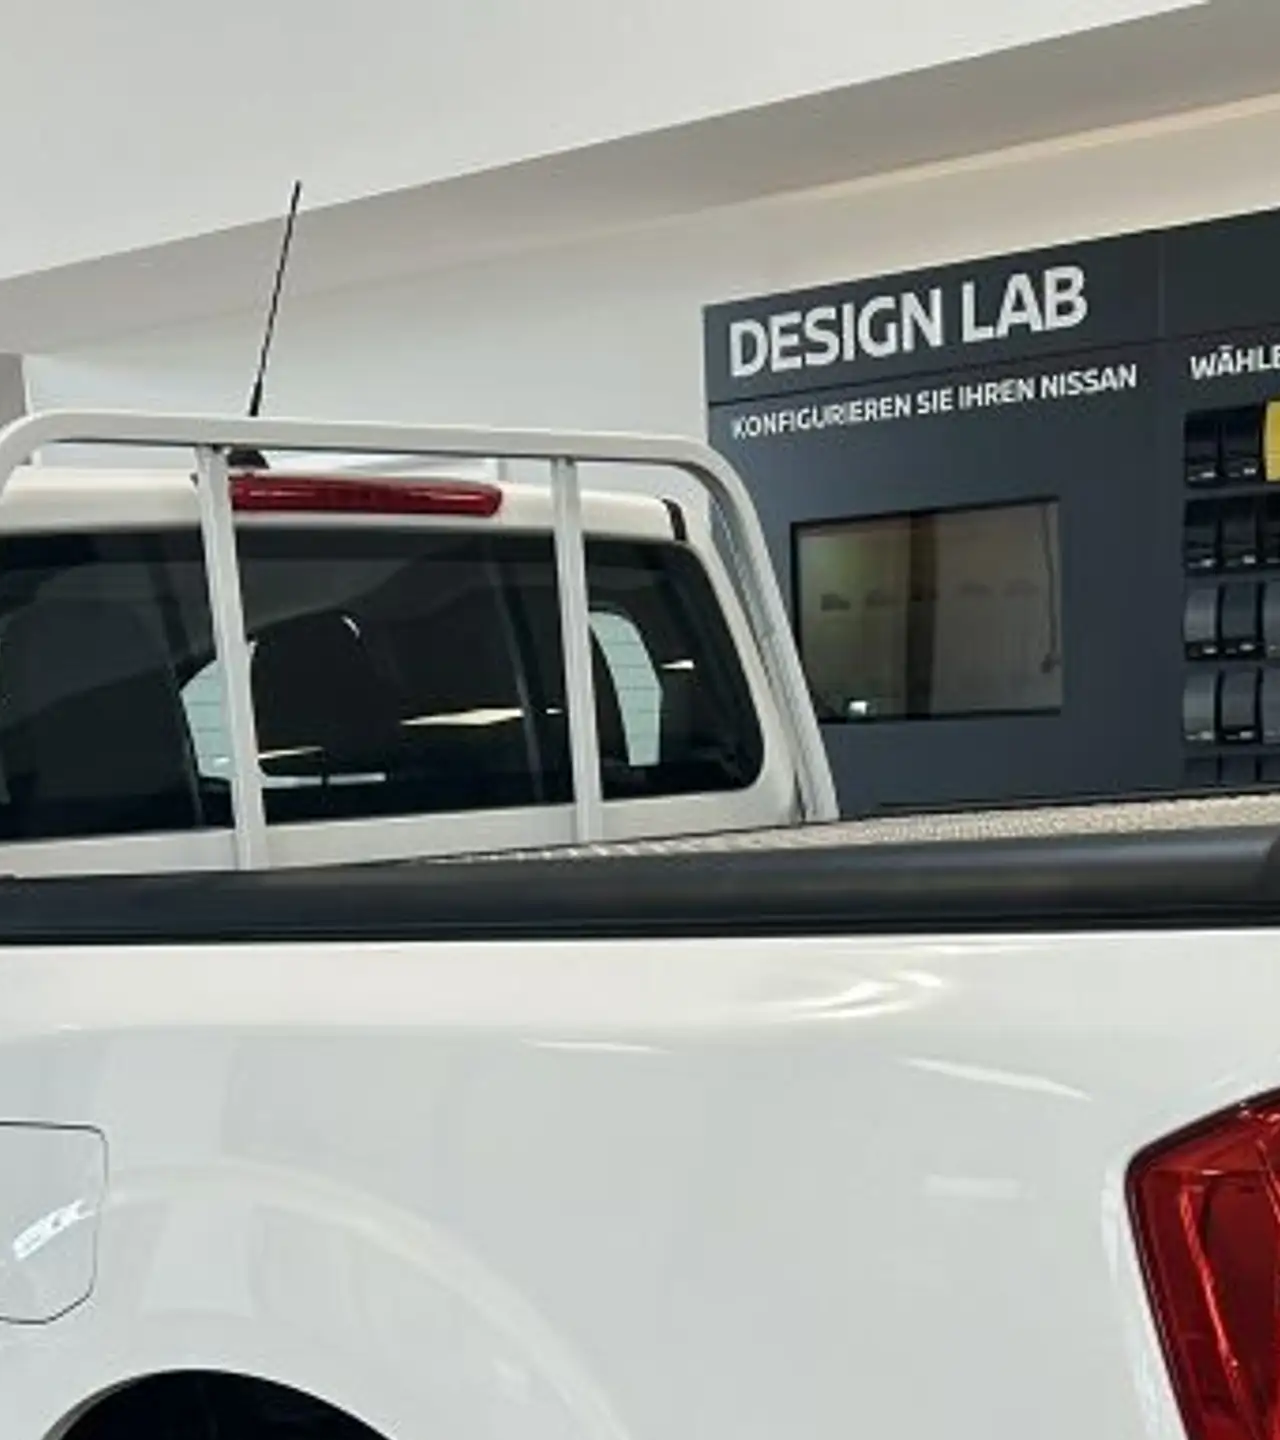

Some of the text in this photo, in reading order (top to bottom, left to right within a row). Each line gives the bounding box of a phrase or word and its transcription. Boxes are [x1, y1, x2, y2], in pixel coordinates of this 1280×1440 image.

[729, 265, 1089, 378] DESIGN LAB
[731, 362, 1139, 440] KONFIGURIEREN SIE IHREN NISSAN
